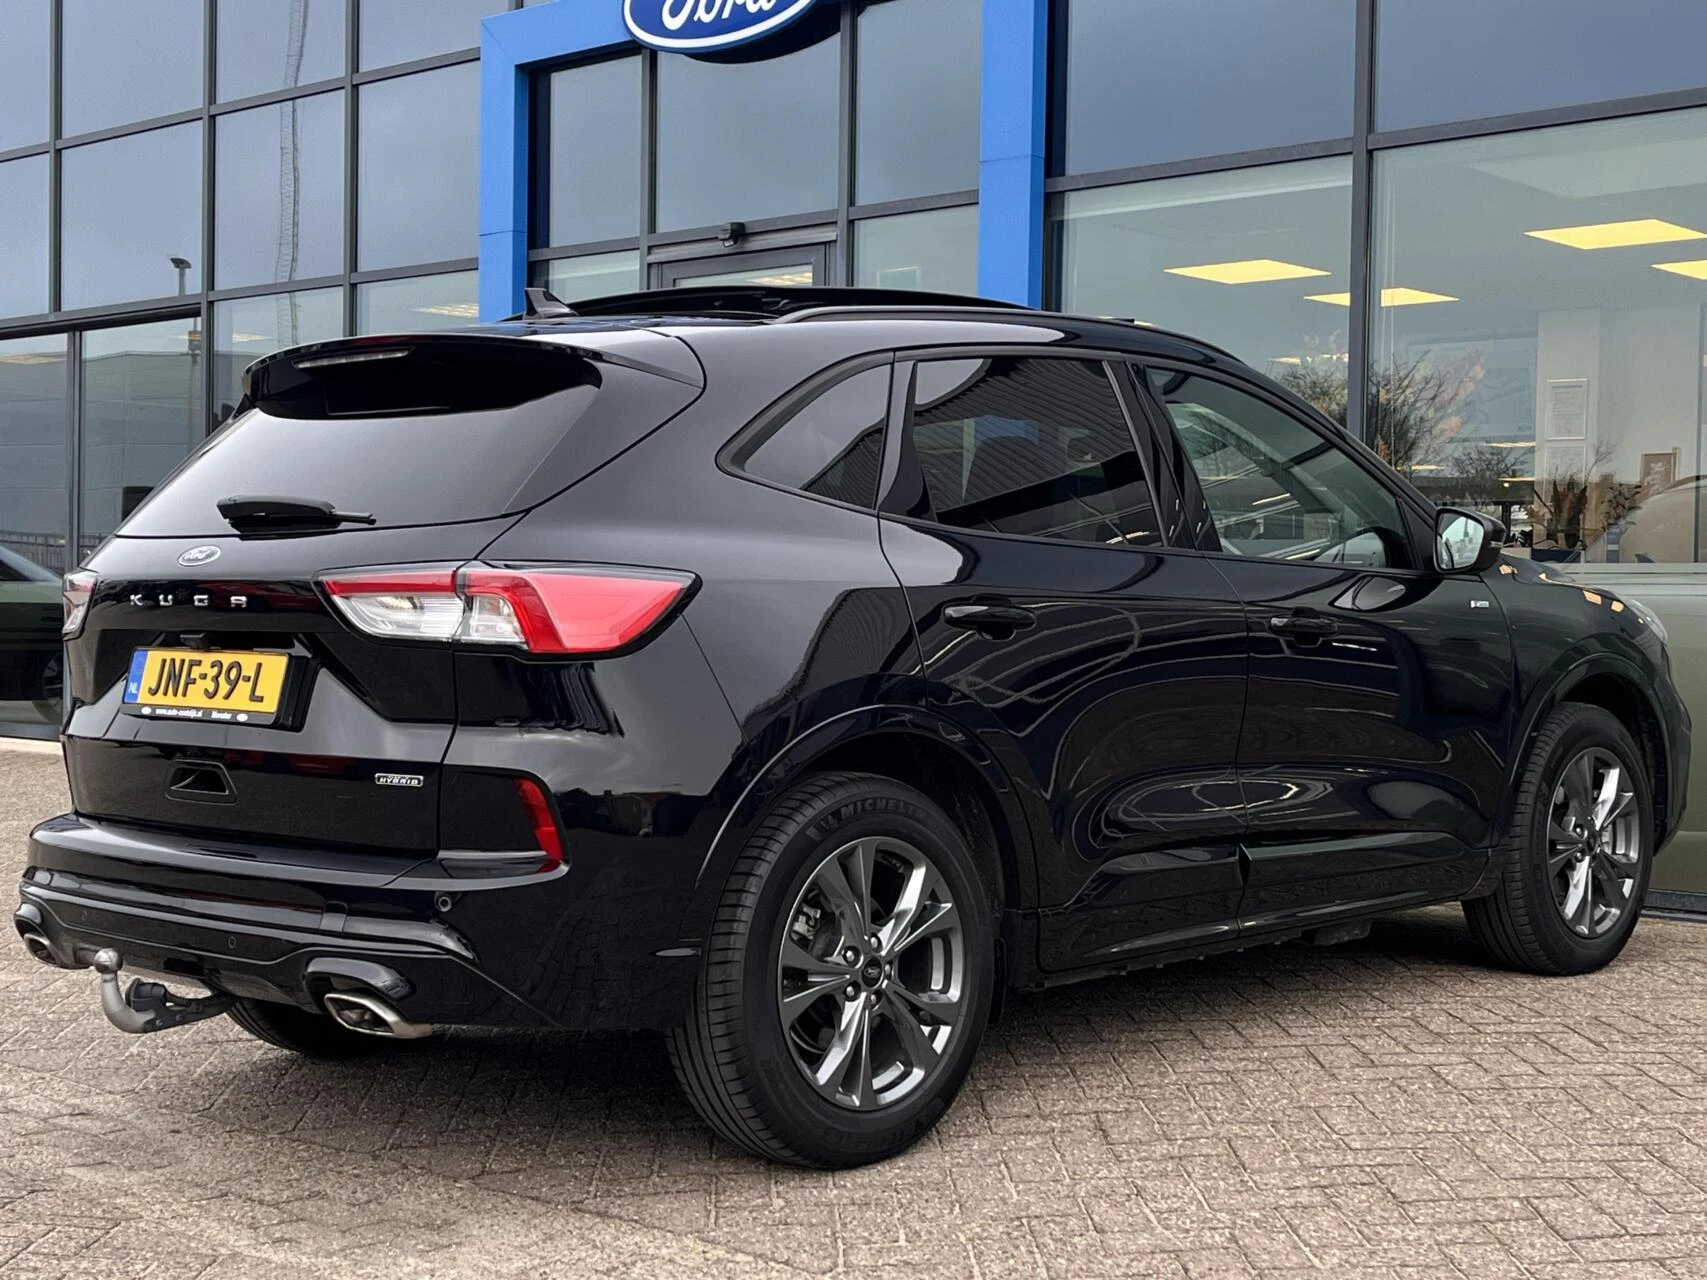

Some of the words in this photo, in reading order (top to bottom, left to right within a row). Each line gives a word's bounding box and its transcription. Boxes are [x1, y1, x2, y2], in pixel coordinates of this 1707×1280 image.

[130, 594, 247, 608] KUGA
[147, 657, 264, 703] JNF-39-L
[128, 681, 138, 694] NL
[379, 777, 418, 785] HYBRID
